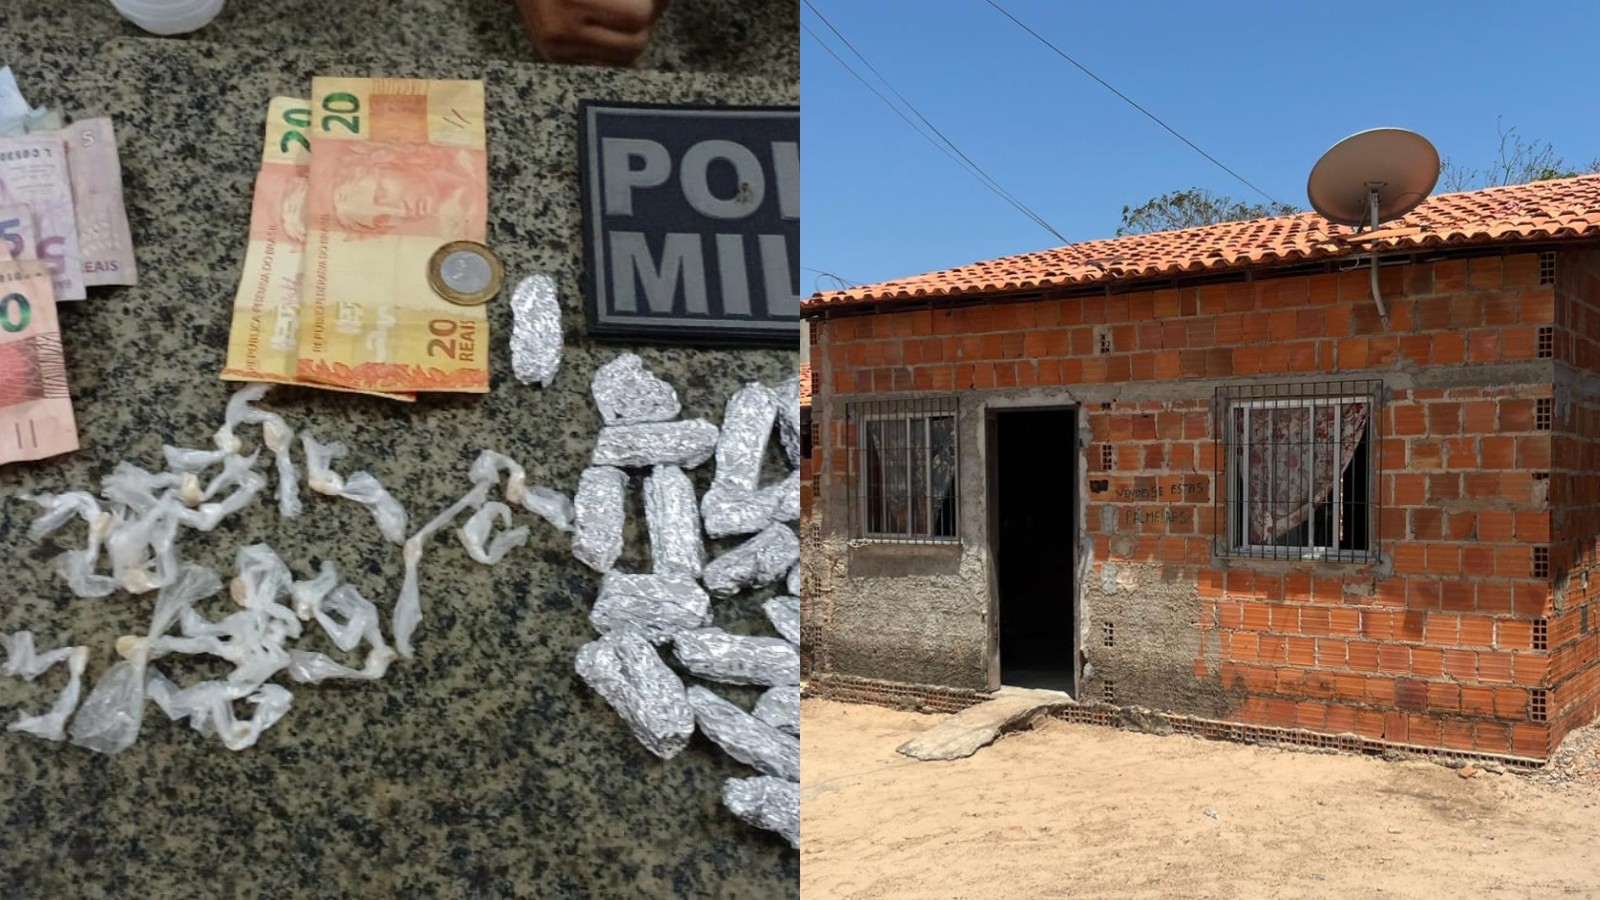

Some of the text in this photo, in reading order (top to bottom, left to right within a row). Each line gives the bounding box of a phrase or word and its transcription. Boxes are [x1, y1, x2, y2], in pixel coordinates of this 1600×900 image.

[280, 107, 312, 153] 20
[321, 92, 360, 134] 20
[82, 129, 94, 147] 5
[0, 218, 24, 258] 5
[427, 318, 458, 360] 20
